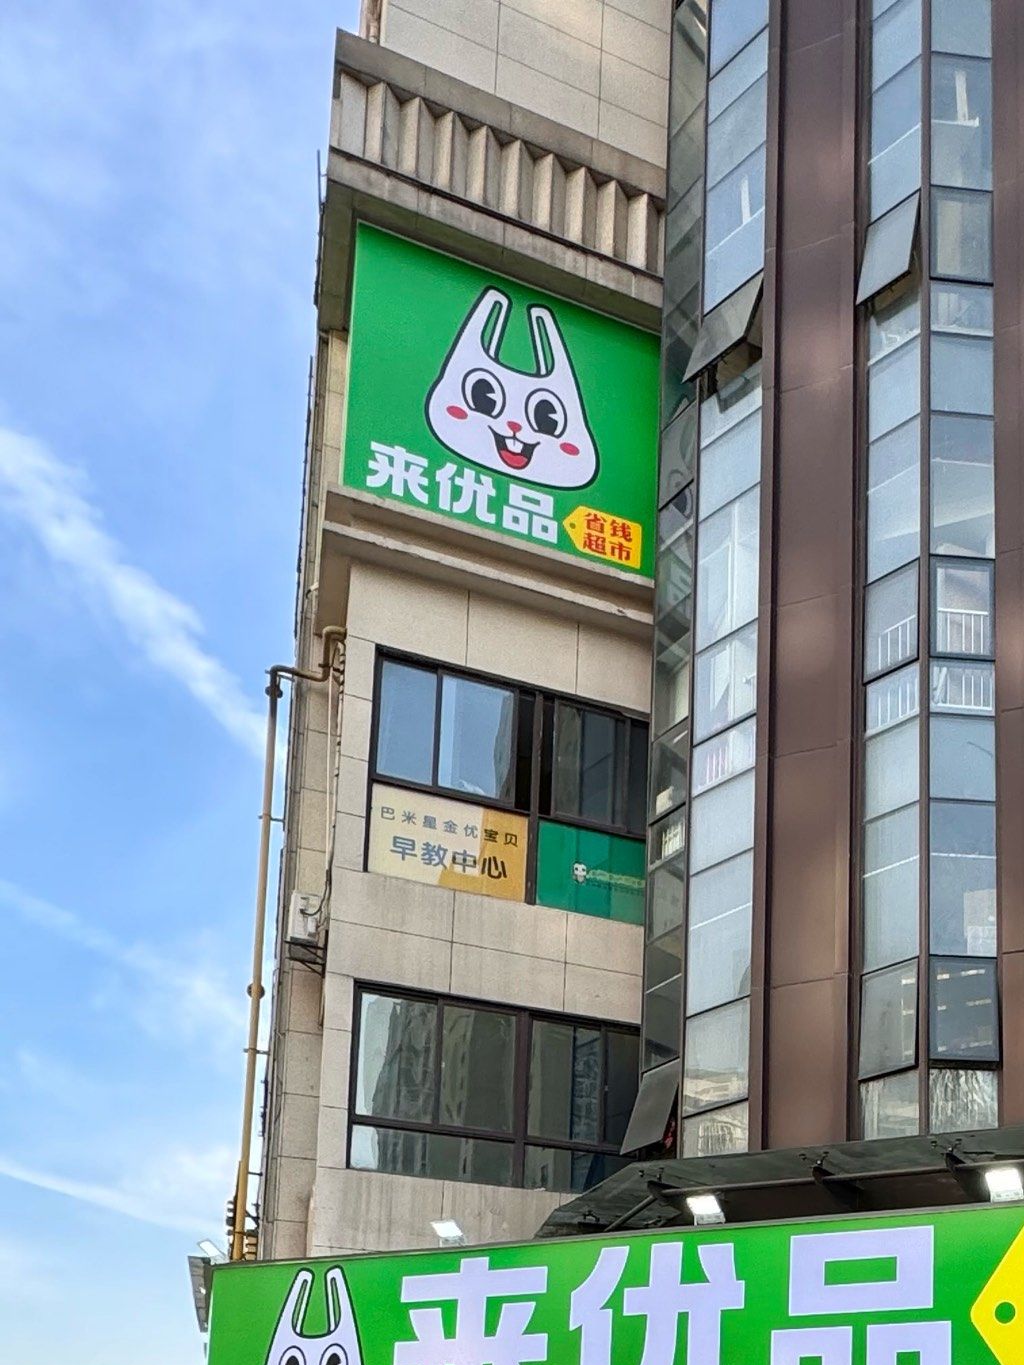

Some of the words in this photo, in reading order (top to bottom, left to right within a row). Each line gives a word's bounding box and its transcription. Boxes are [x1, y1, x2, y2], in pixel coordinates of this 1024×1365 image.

[366, 441, 558, 544] 来优品
[584, 511, 632, 543] 省钱
[583, 532, 631, 562] 超市
[390, 835, 507, 879] 早教中心
